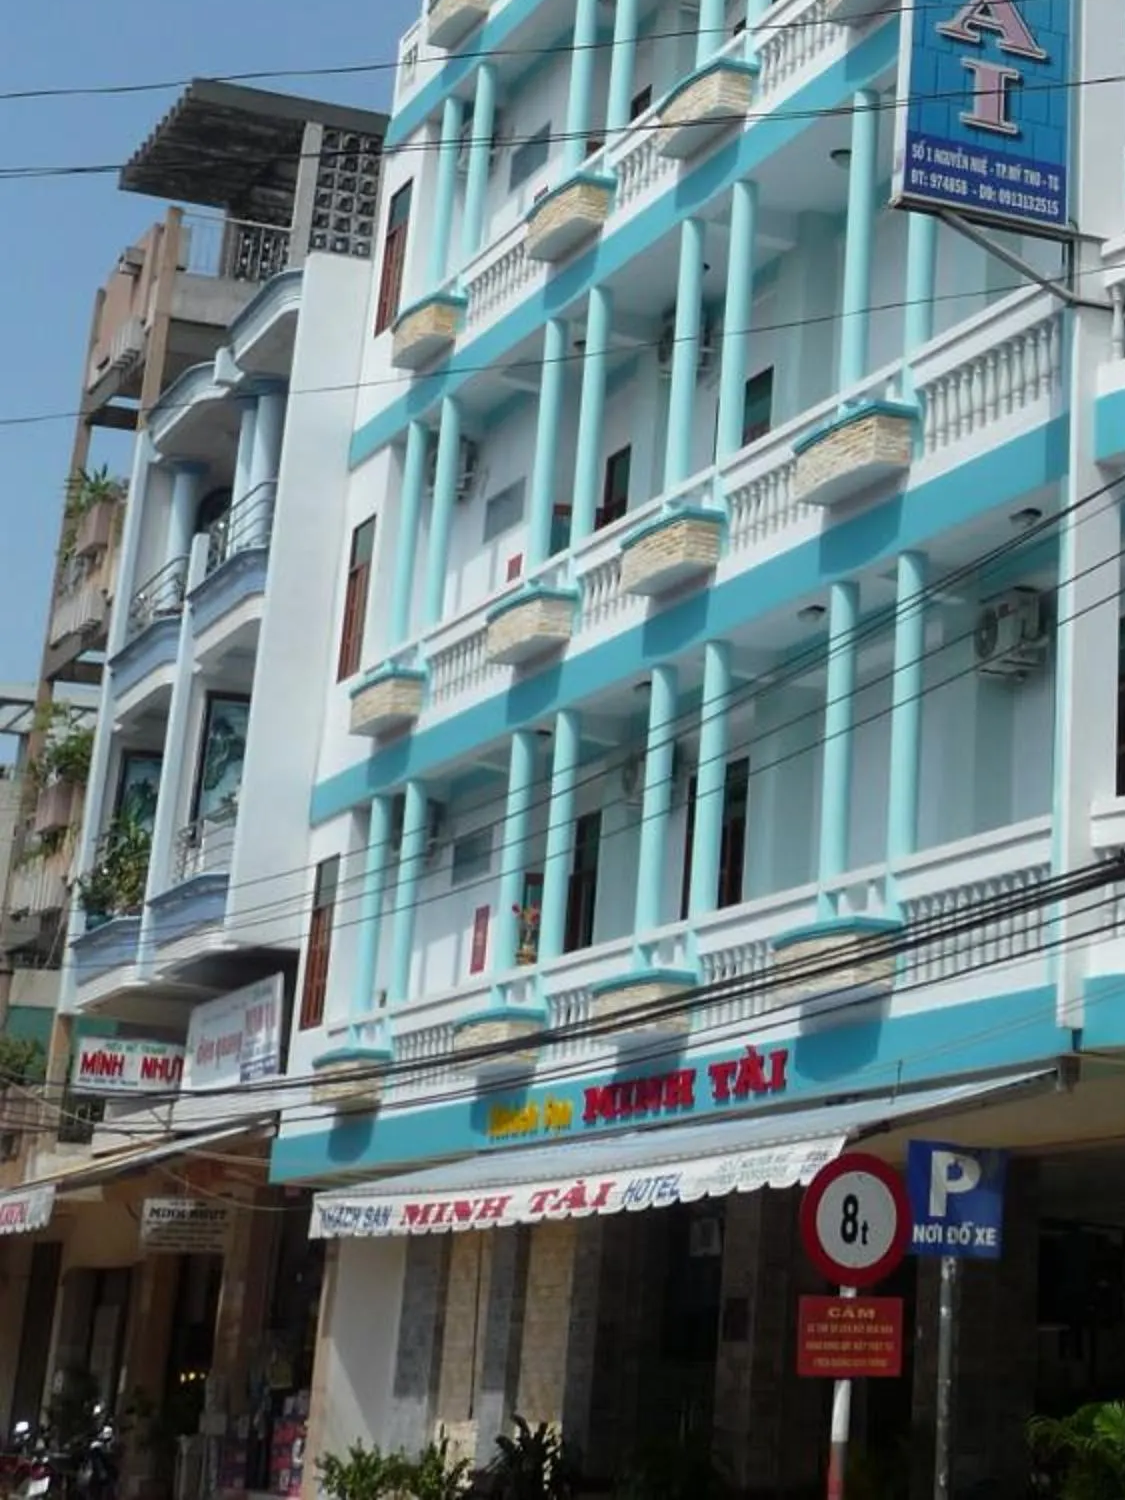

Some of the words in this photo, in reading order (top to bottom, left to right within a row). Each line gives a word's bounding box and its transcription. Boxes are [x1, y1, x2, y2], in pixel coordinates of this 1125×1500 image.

[583, 1067, 697, 1125] MINH
[707, 1043, 789, 1101] TÀI
[399, 1194, 512, 1227] MINH
[528, 1178, 616, 1217] TÀI
[621, 1171, 683, 1204] HOTEL
[929, 1148, 983, 1217] P
[912, 1222, 943, 1244] NƠI
[973, 1226, 997, 1248] XE
